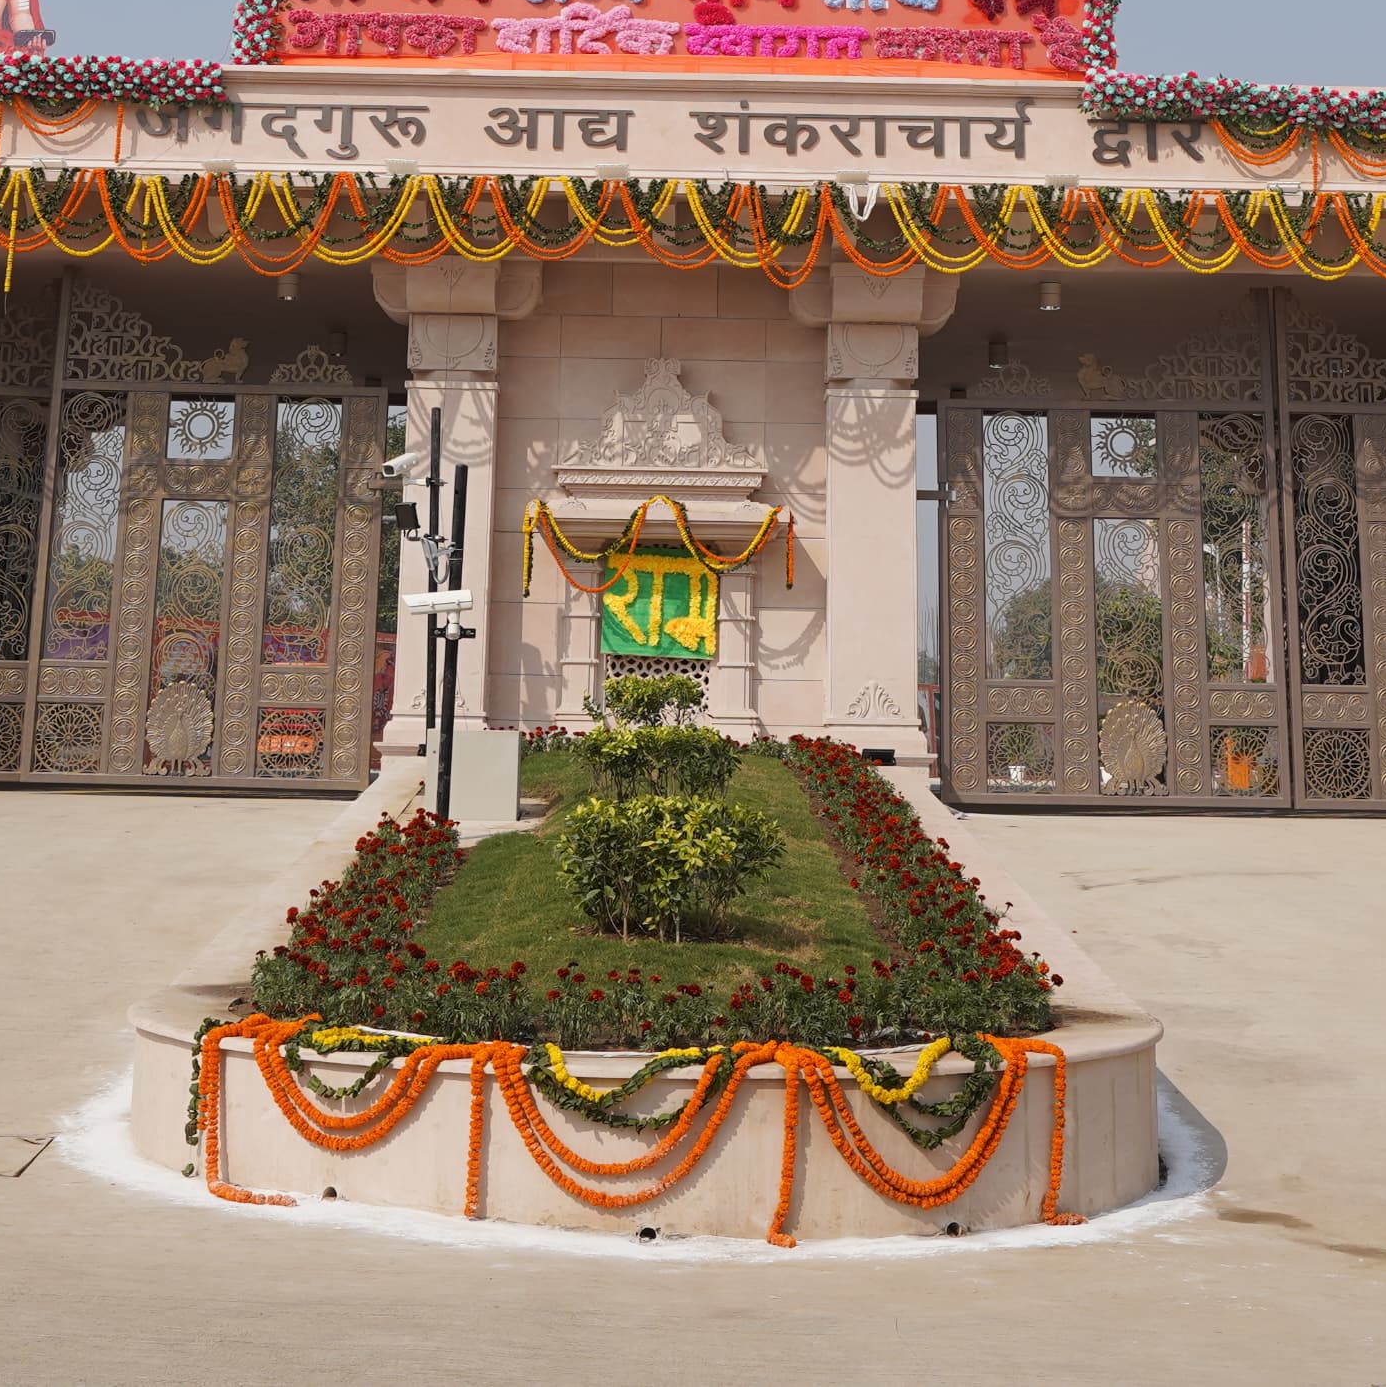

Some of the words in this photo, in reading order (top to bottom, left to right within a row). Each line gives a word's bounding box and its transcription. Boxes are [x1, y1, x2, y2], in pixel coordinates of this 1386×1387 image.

[484, 107, 634, 151] आद्य
[689, 98, 1034, 159] शंकराचार्य
[603, 553, 718, 656] राम
